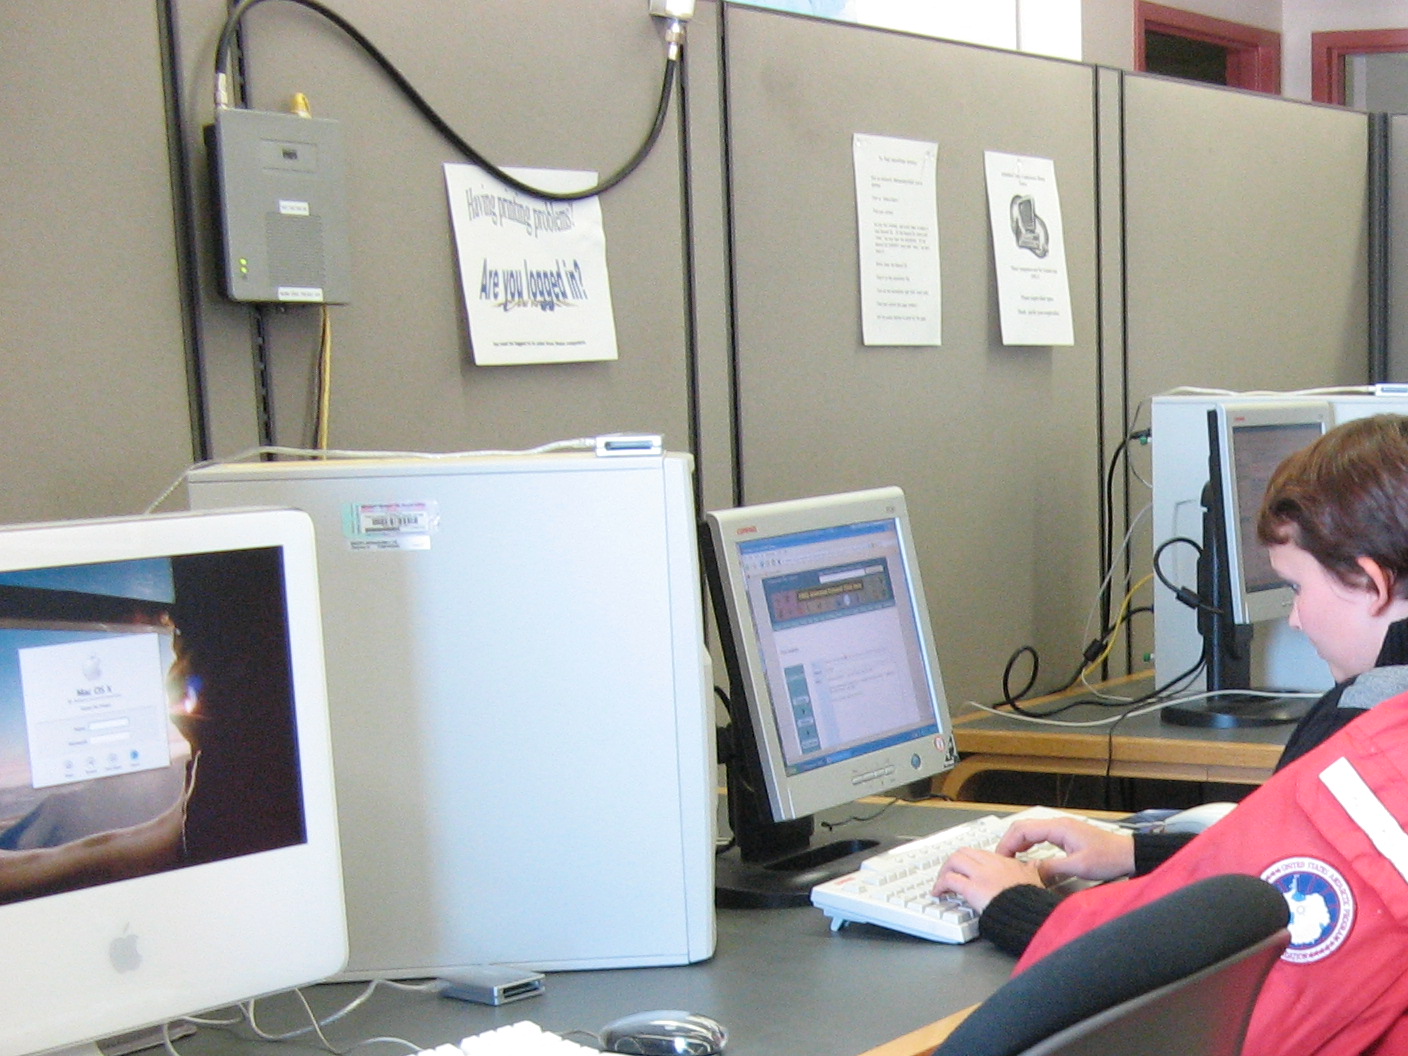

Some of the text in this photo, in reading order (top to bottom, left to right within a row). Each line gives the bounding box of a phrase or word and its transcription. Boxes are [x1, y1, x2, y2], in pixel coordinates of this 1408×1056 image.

[465, 183, 498, 226] Having
[497, 187, 532, 236] printing
[479, 257, 588, 312] Are you logged in?
[76, 687, 91, 696] Mac
